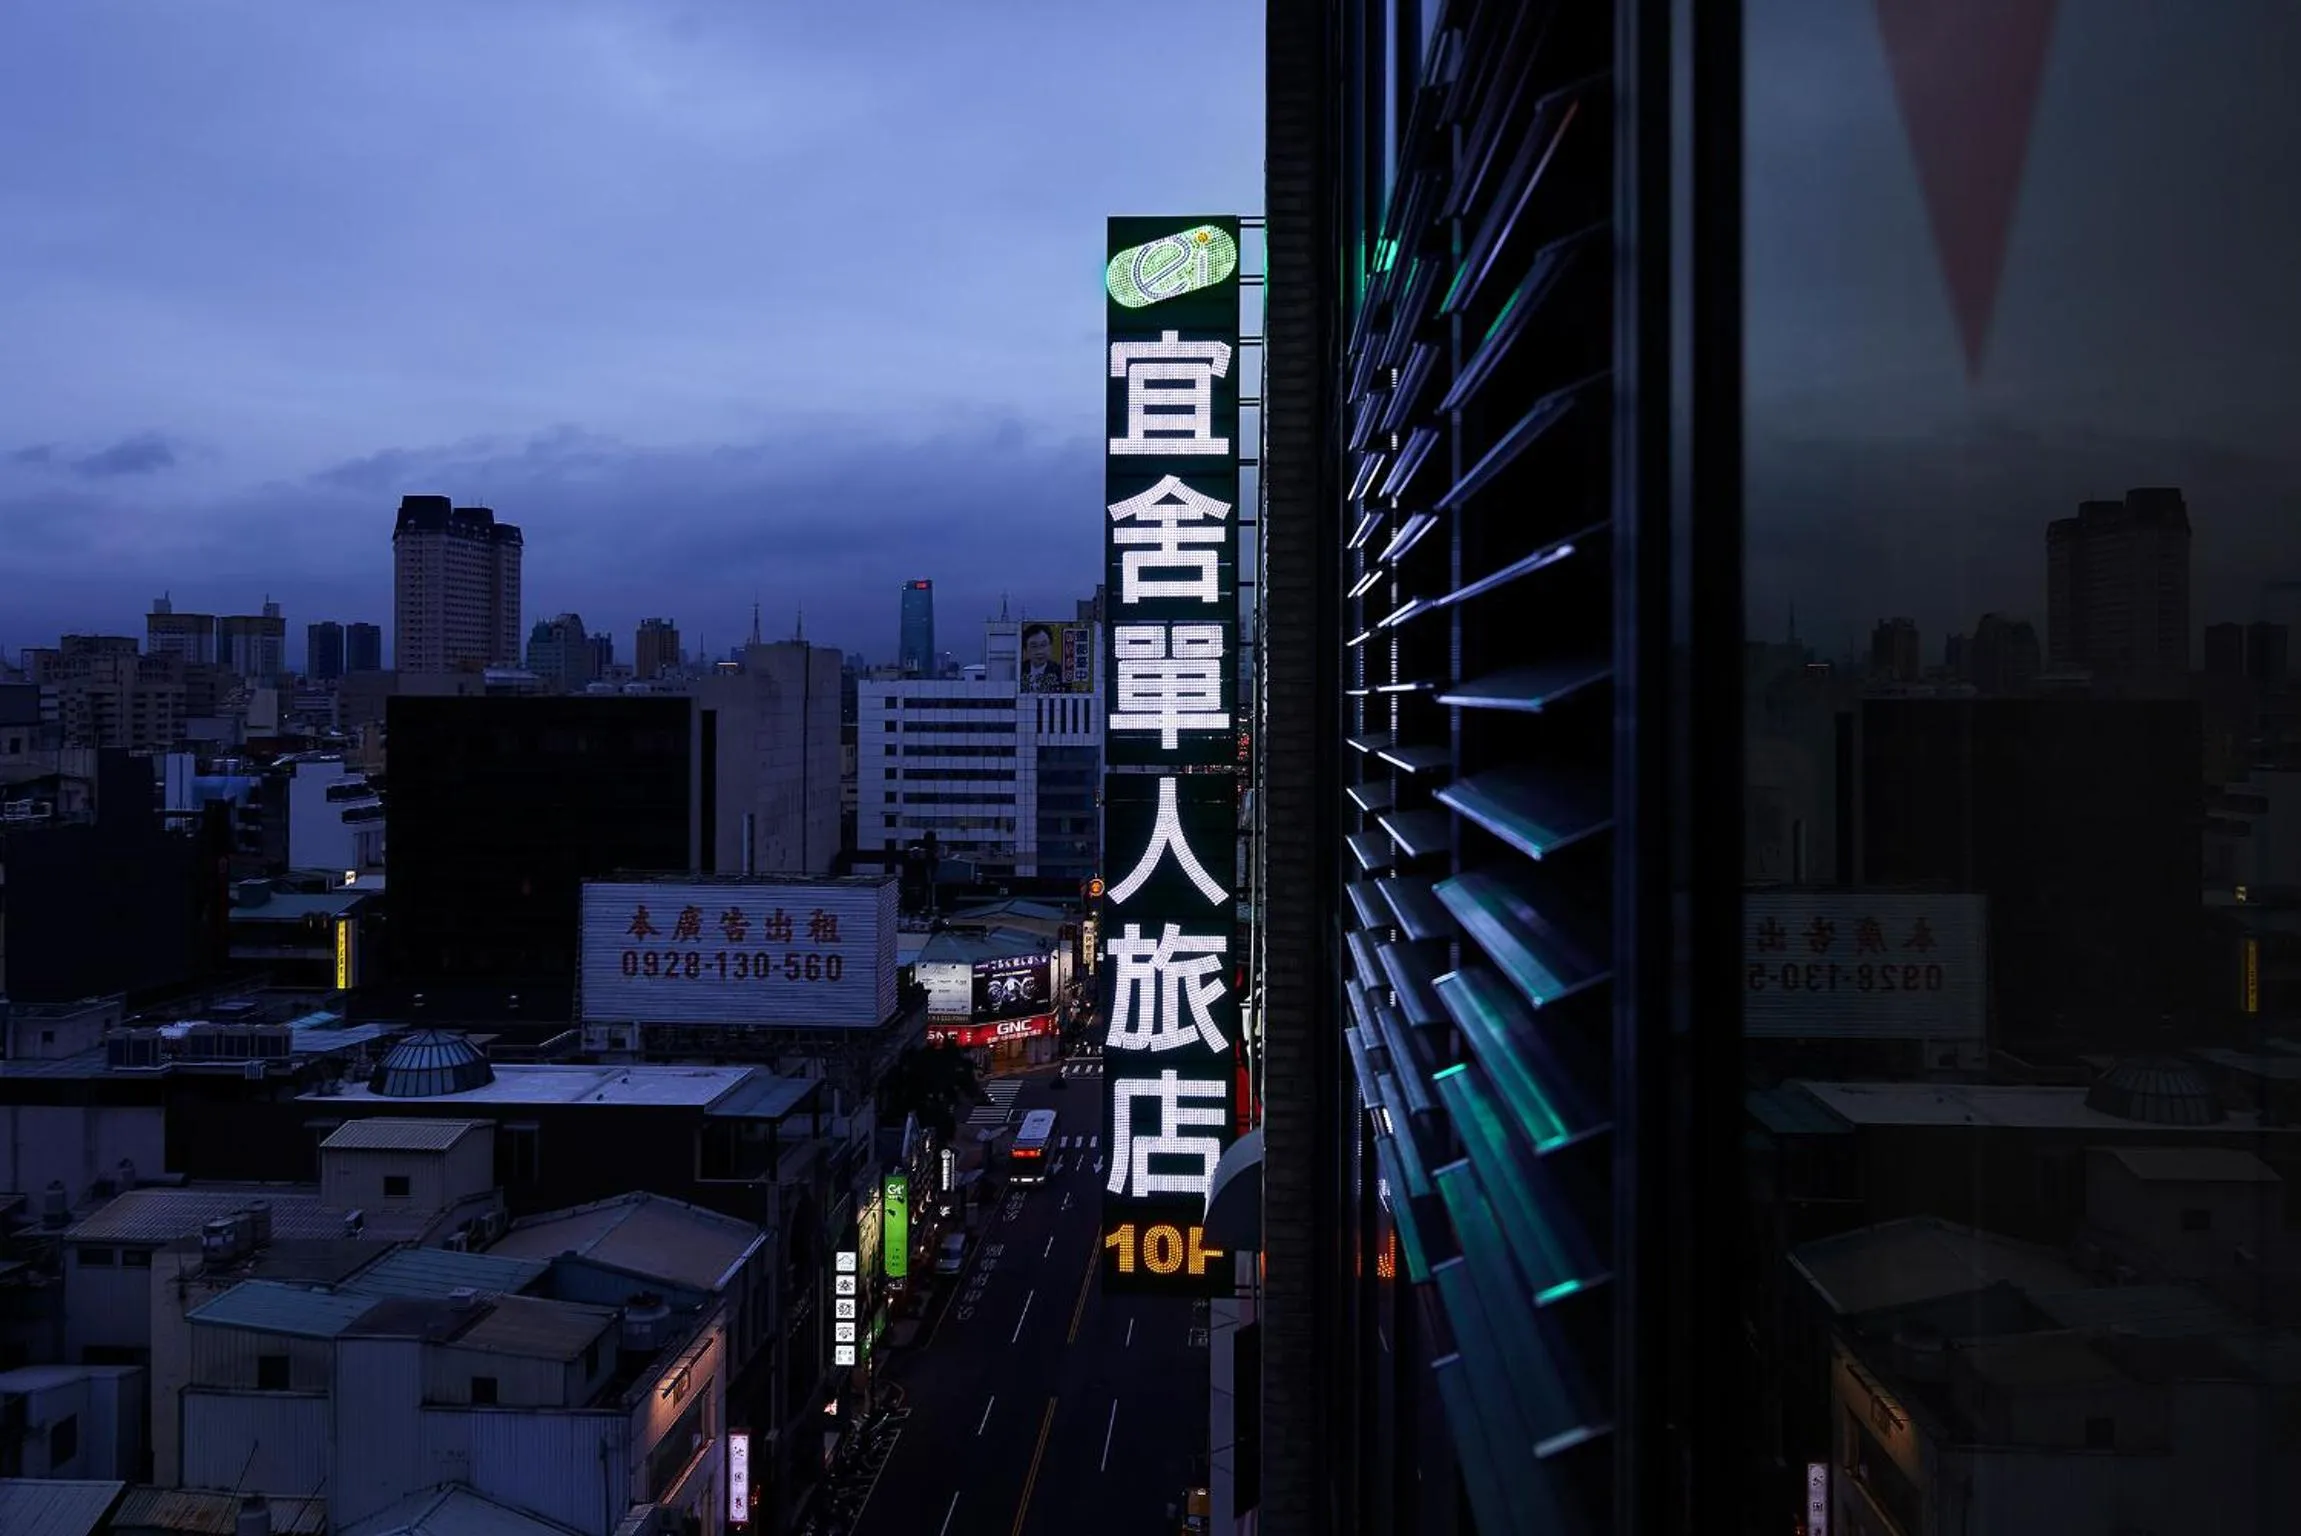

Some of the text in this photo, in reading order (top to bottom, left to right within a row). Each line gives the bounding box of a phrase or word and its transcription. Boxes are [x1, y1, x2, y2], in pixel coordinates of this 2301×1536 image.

[1107, 329, 1232, 1204] 宜舍單人旅店
[626, 904, 841, 943] 本廣告出租
[622, 949, 843, 982] 0928-130-560
[997, 1019, 1032, 1035] GNC
